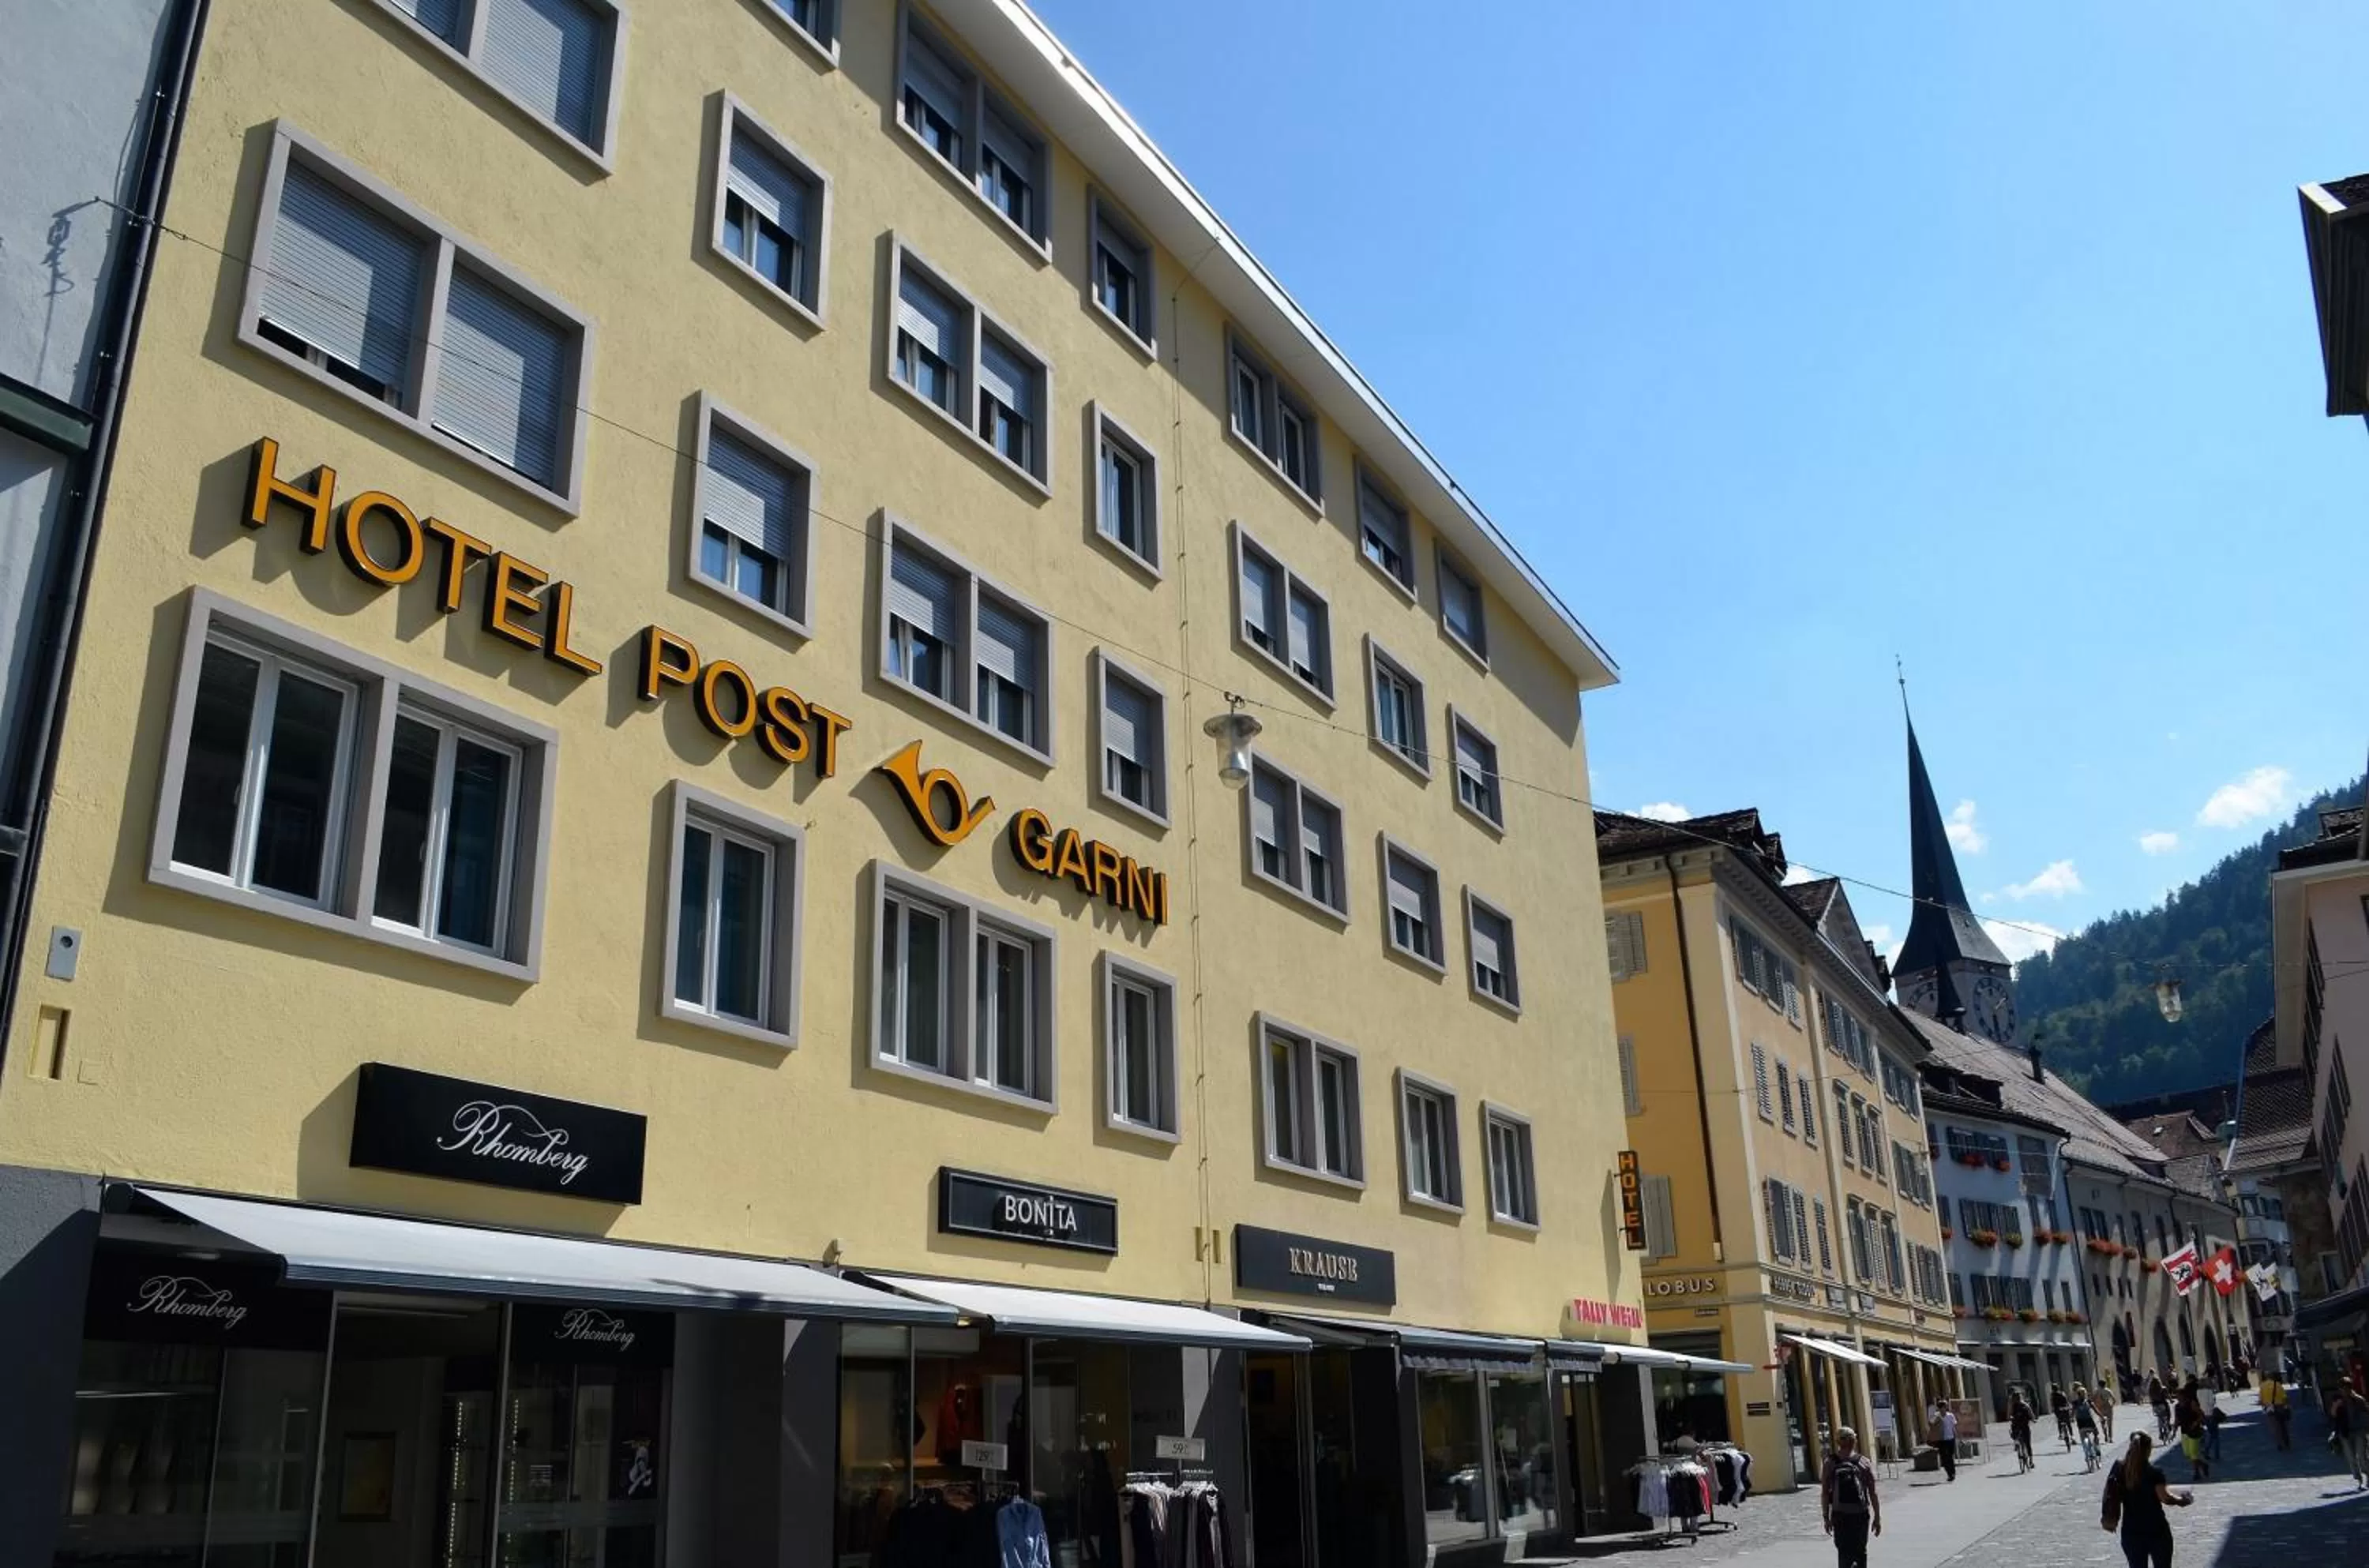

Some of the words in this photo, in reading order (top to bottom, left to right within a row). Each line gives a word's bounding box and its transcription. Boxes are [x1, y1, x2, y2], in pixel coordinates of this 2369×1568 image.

[243, 437, 603, 677] HOTEL
[638, 625, 853, 778] POST
[1009, 808, 1169, 925] GARNI
[436, 1100, 588, 1185] Rhomberg
[1620, 1153, 1642, 1247] HOTEL
[1289, 1247, 1358, 1282] KRAUSE
[1647, 1277, 1716, 1296] LOBUS
[126, 1275, 247, 1330] Rhomberg
[554, 1308, 636, 1352] Rhomberg
